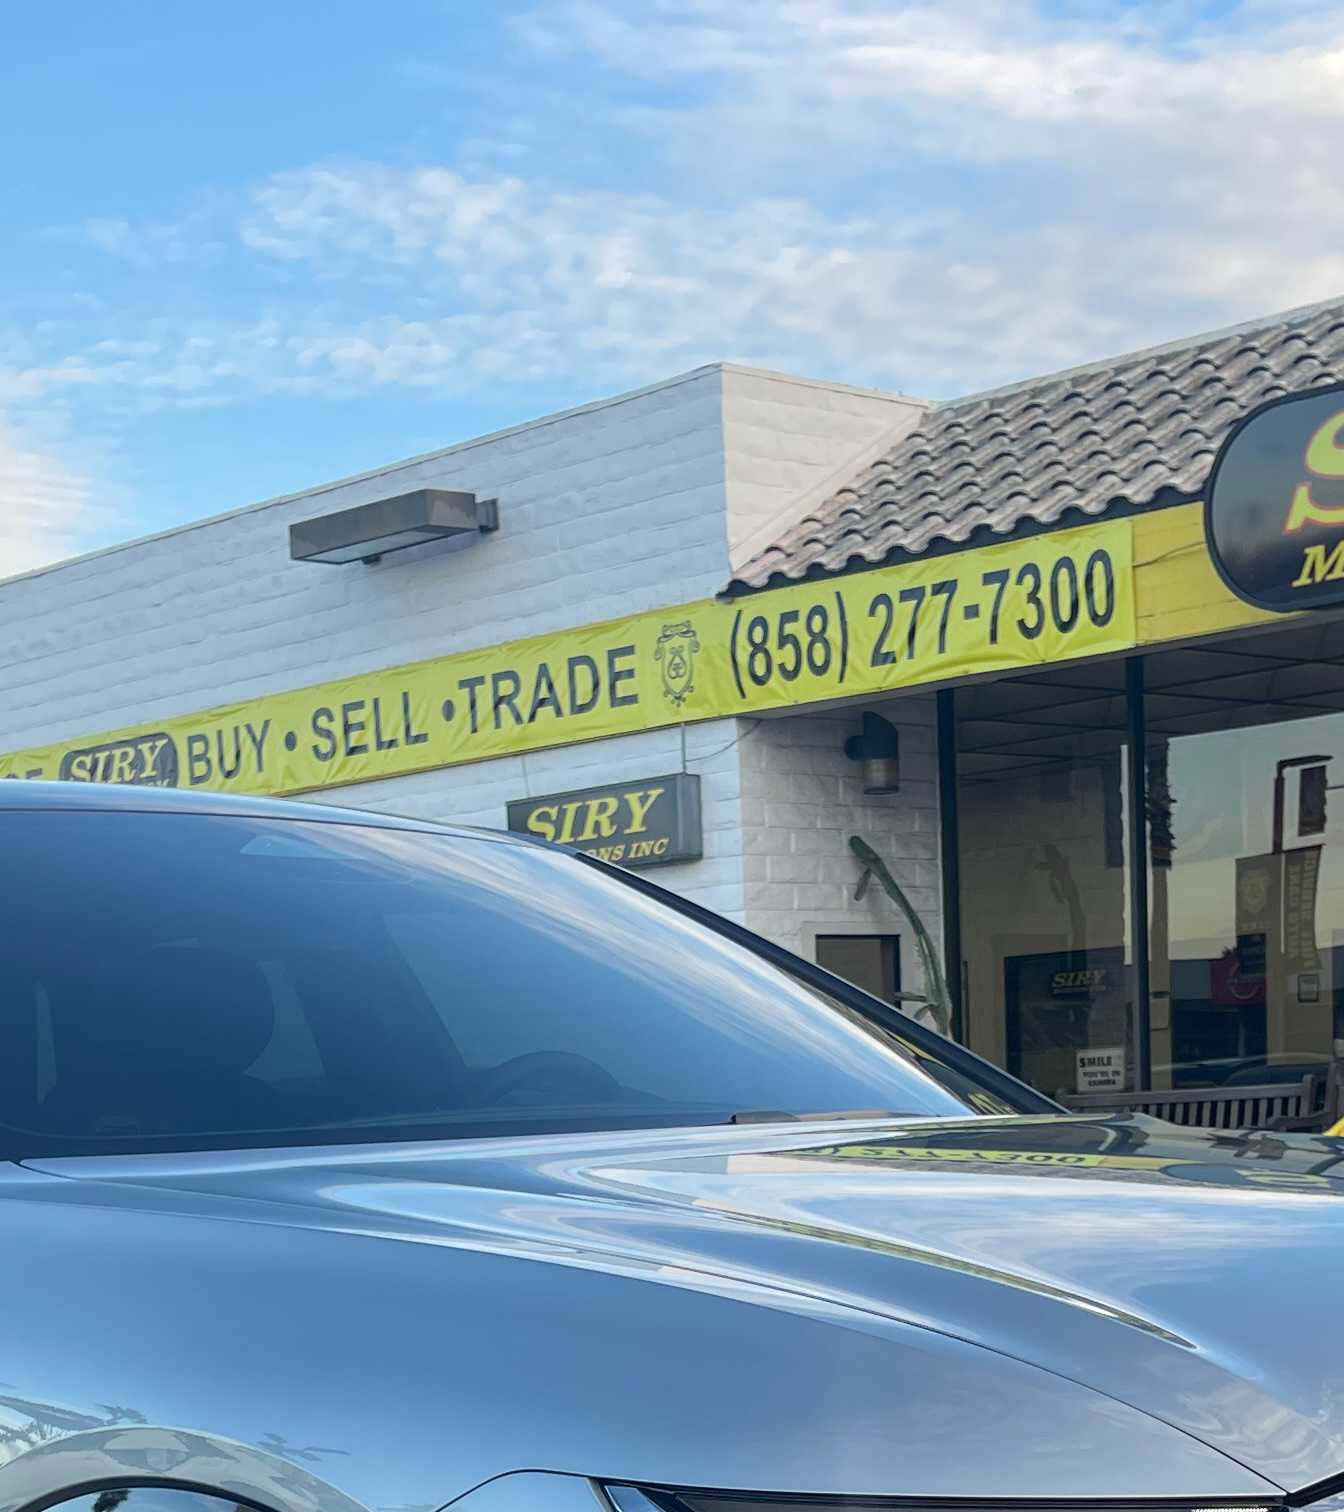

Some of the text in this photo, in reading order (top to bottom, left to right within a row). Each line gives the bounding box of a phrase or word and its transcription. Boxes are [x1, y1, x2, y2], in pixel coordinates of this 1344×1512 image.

[730, 549, 1115, 699] (858) 277-7300
[187, 644, 639, 786] BUY SELL TRADE
[70, 737, 169, 784] SIRY
[527, 787, 665, 844] SIRY
[628, 838, 669, 859] INC
